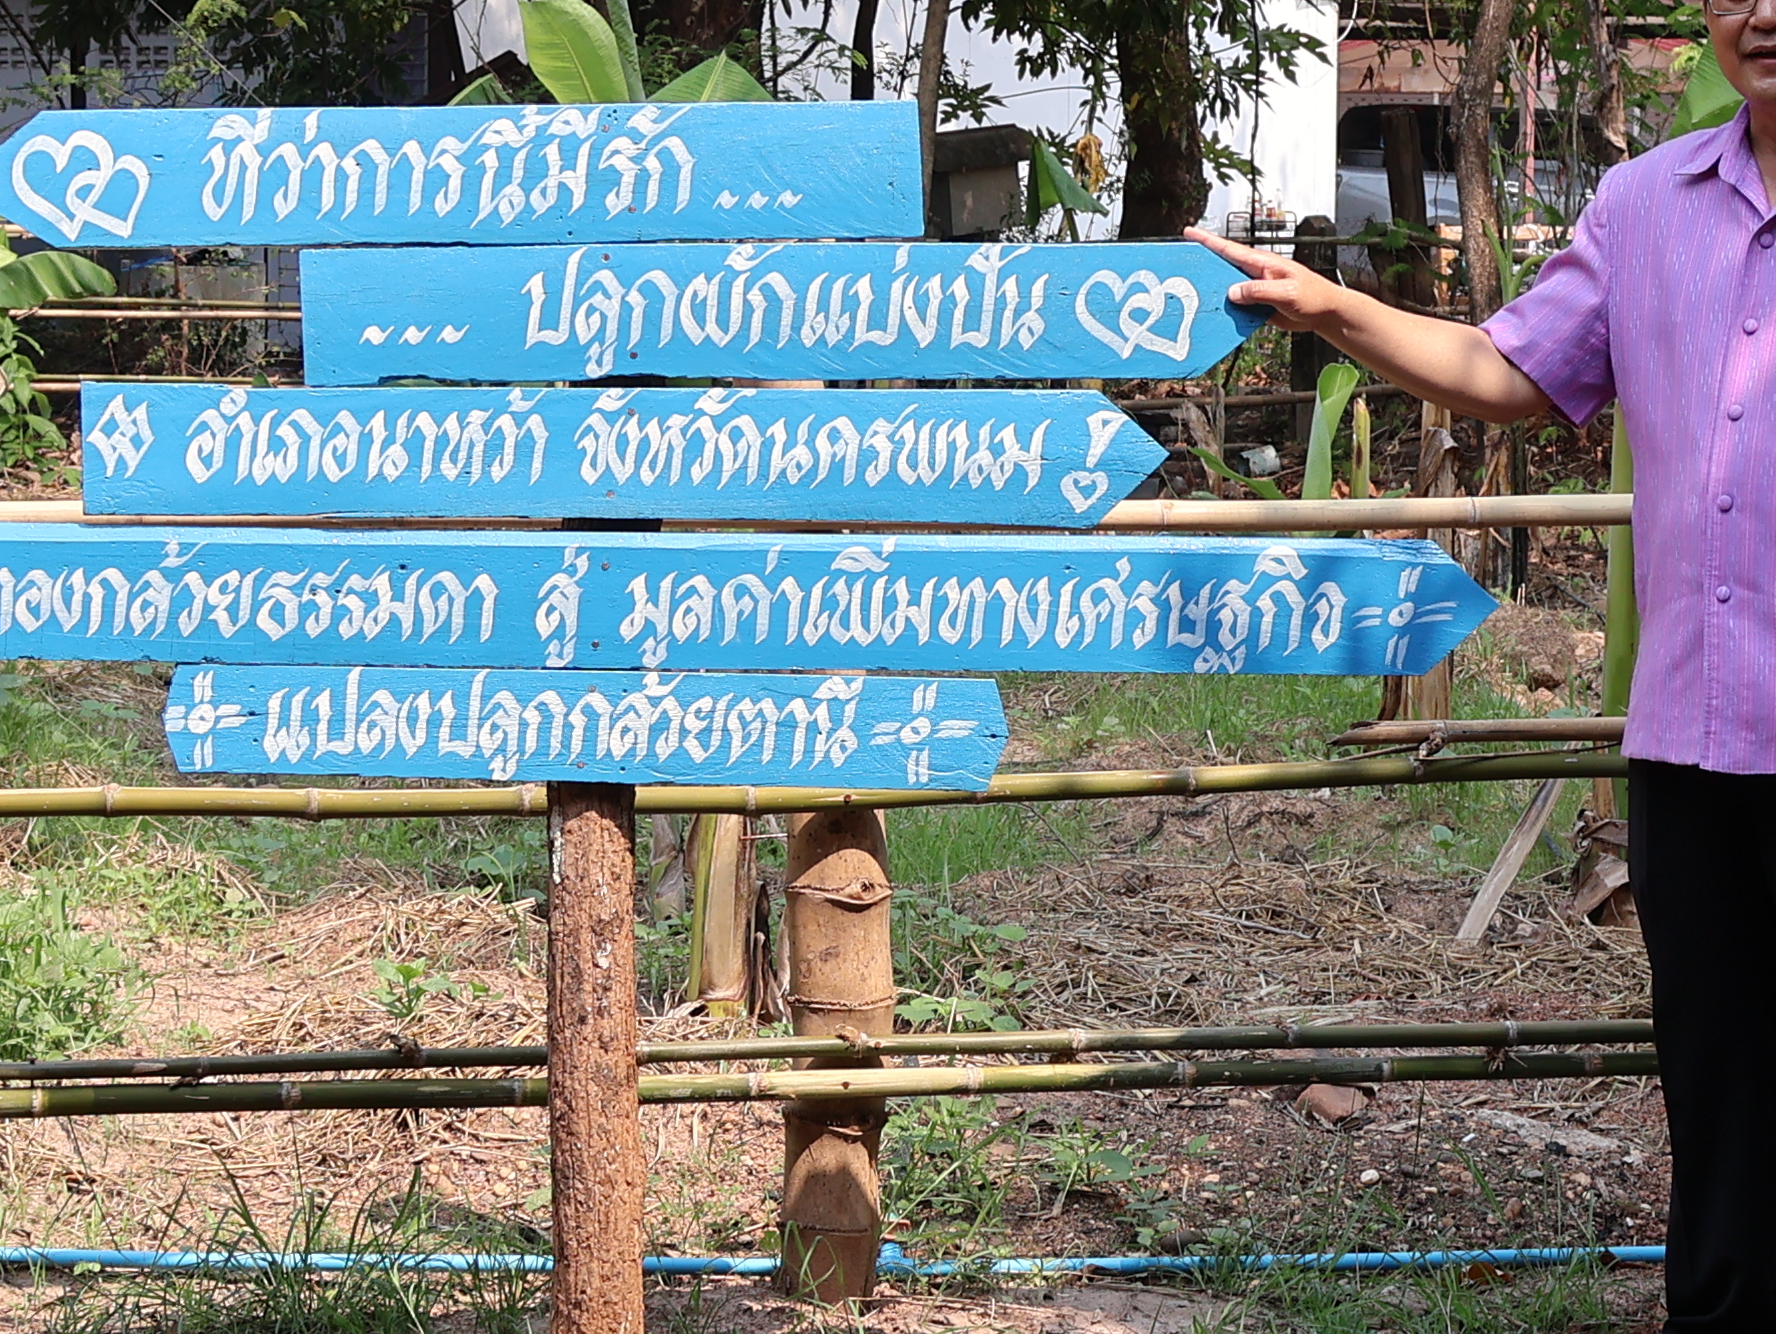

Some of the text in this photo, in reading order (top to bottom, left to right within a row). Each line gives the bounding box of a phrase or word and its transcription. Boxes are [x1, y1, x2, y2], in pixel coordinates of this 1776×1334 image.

[522, 244, 1050, 379] ปลูกผักแบ่งปัน
[184, 387, 550, 487] อำเภอนาหว้า
[535, 541, 590, 666] สู่
[262, 667, 866, 781] แปลงปลูกกล้วยตานี
